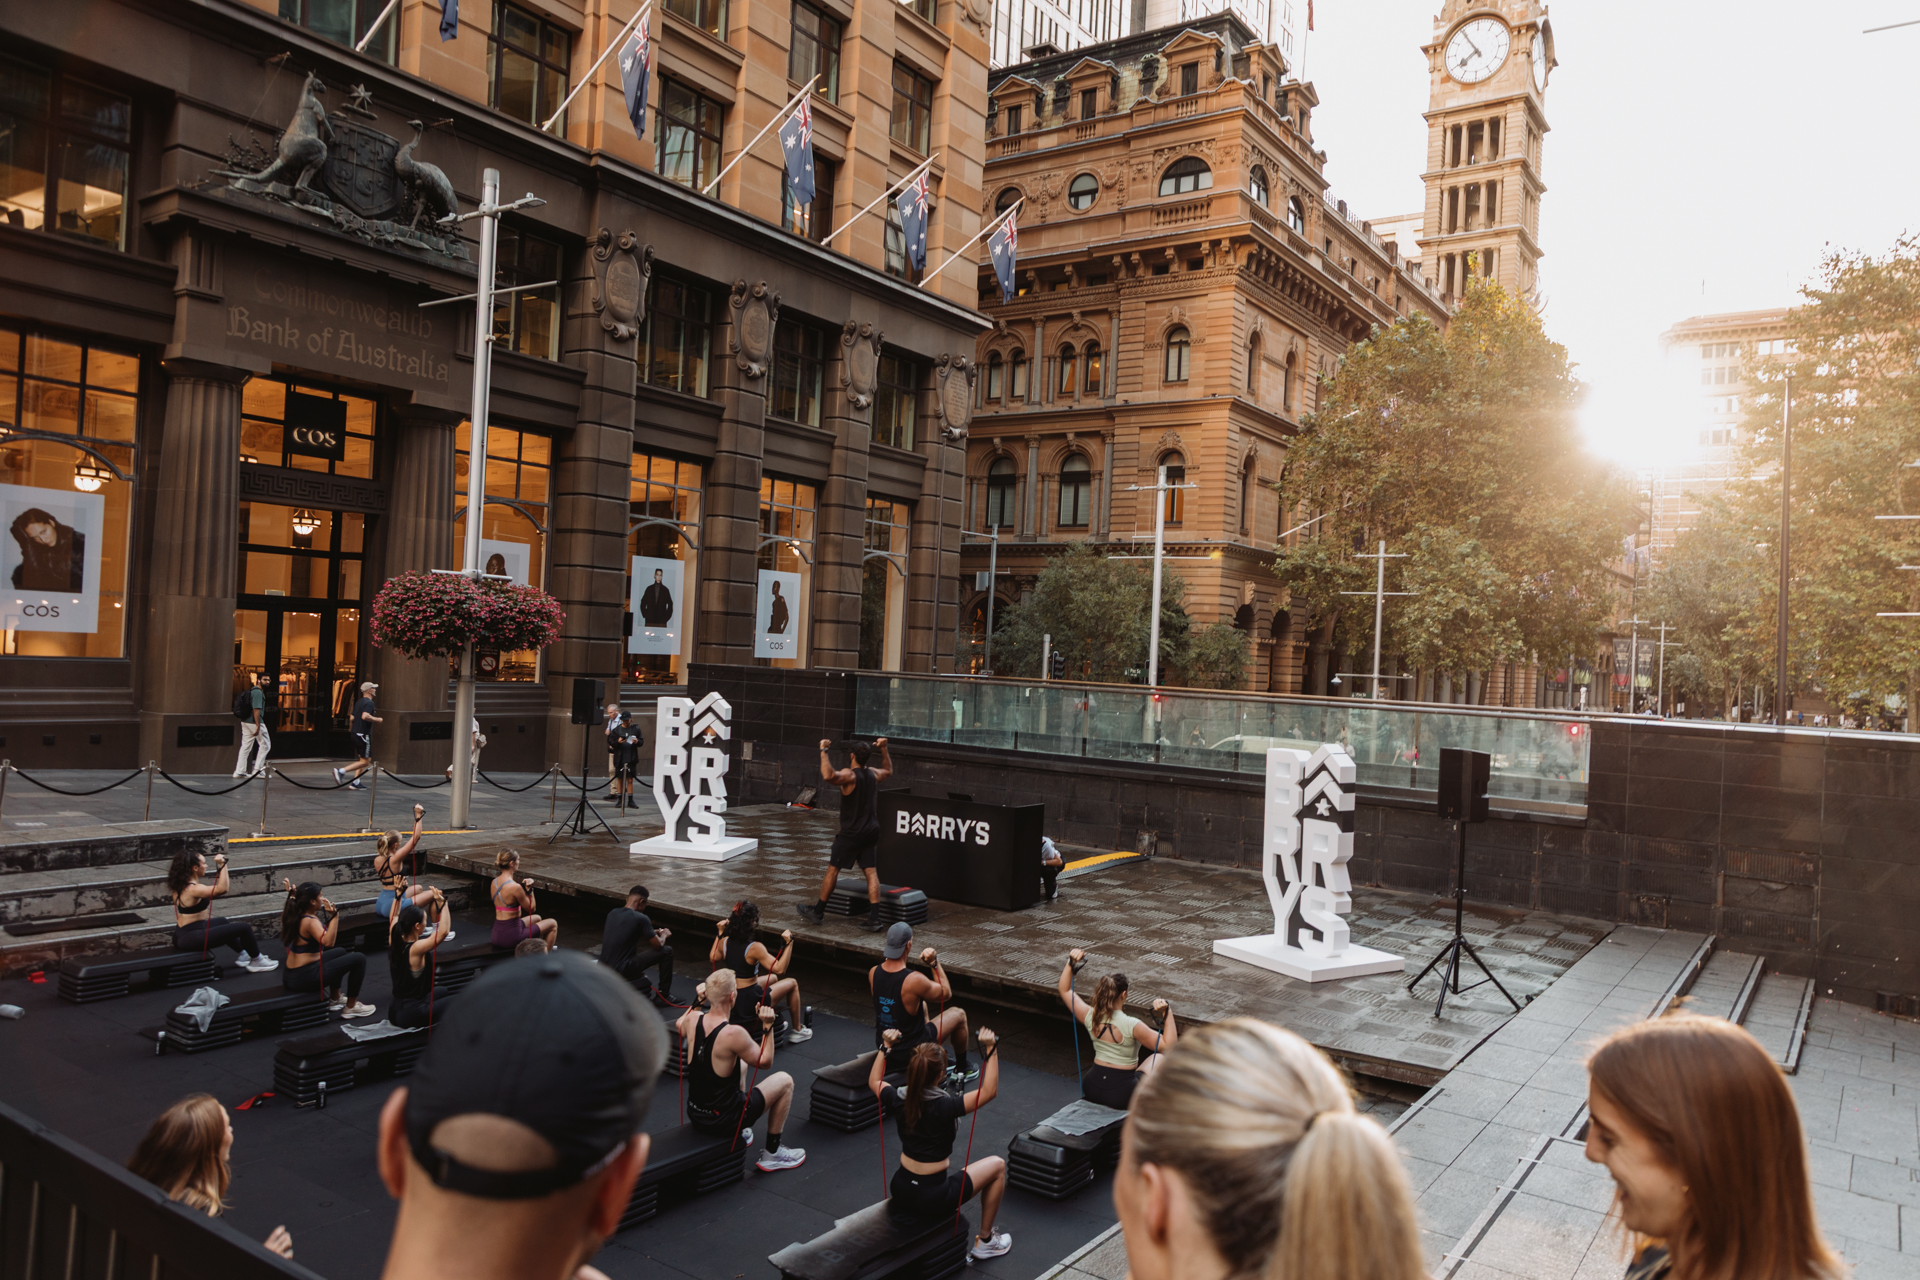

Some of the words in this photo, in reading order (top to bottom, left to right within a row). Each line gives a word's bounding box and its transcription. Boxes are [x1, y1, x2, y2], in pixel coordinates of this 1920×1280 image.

[253, 267, 433, 339] Commonwealth
[227, 304, 300, 349] Bank
[307, 327, 333, 357] of
[335, 329, 449, 383] Australia
[23, 604, 60, 618] COS
[769, 641, 784, 650] COS
[194, 731, 219, 740] COS
[422, 726, 441, 735] COS
